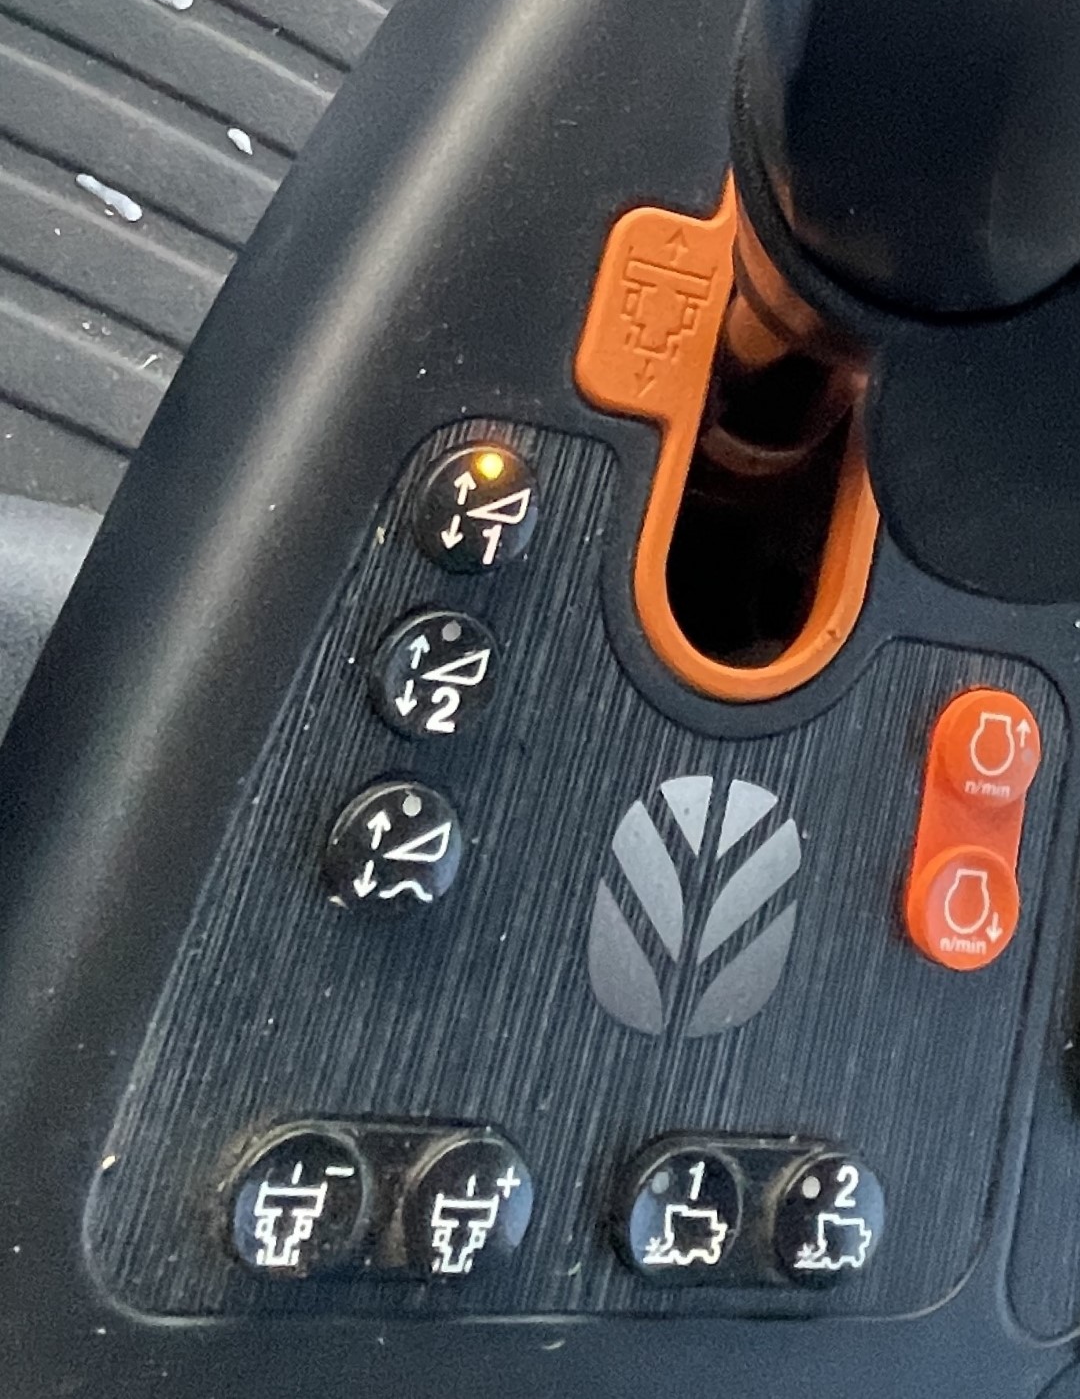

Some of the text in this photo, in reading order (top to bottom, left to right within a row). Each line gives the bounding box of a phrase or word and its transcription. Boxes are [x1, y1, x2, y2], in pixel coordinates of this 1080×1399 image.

[482, 523, 502, 565] 1
[425, 685, 460, 733] 2
[964, 778, 1011, 799] n/min
[940, 934, 987, 955] n/min
[688, 1161, 705, 1200] 1
[834, 1164, 859, 1208] 2
